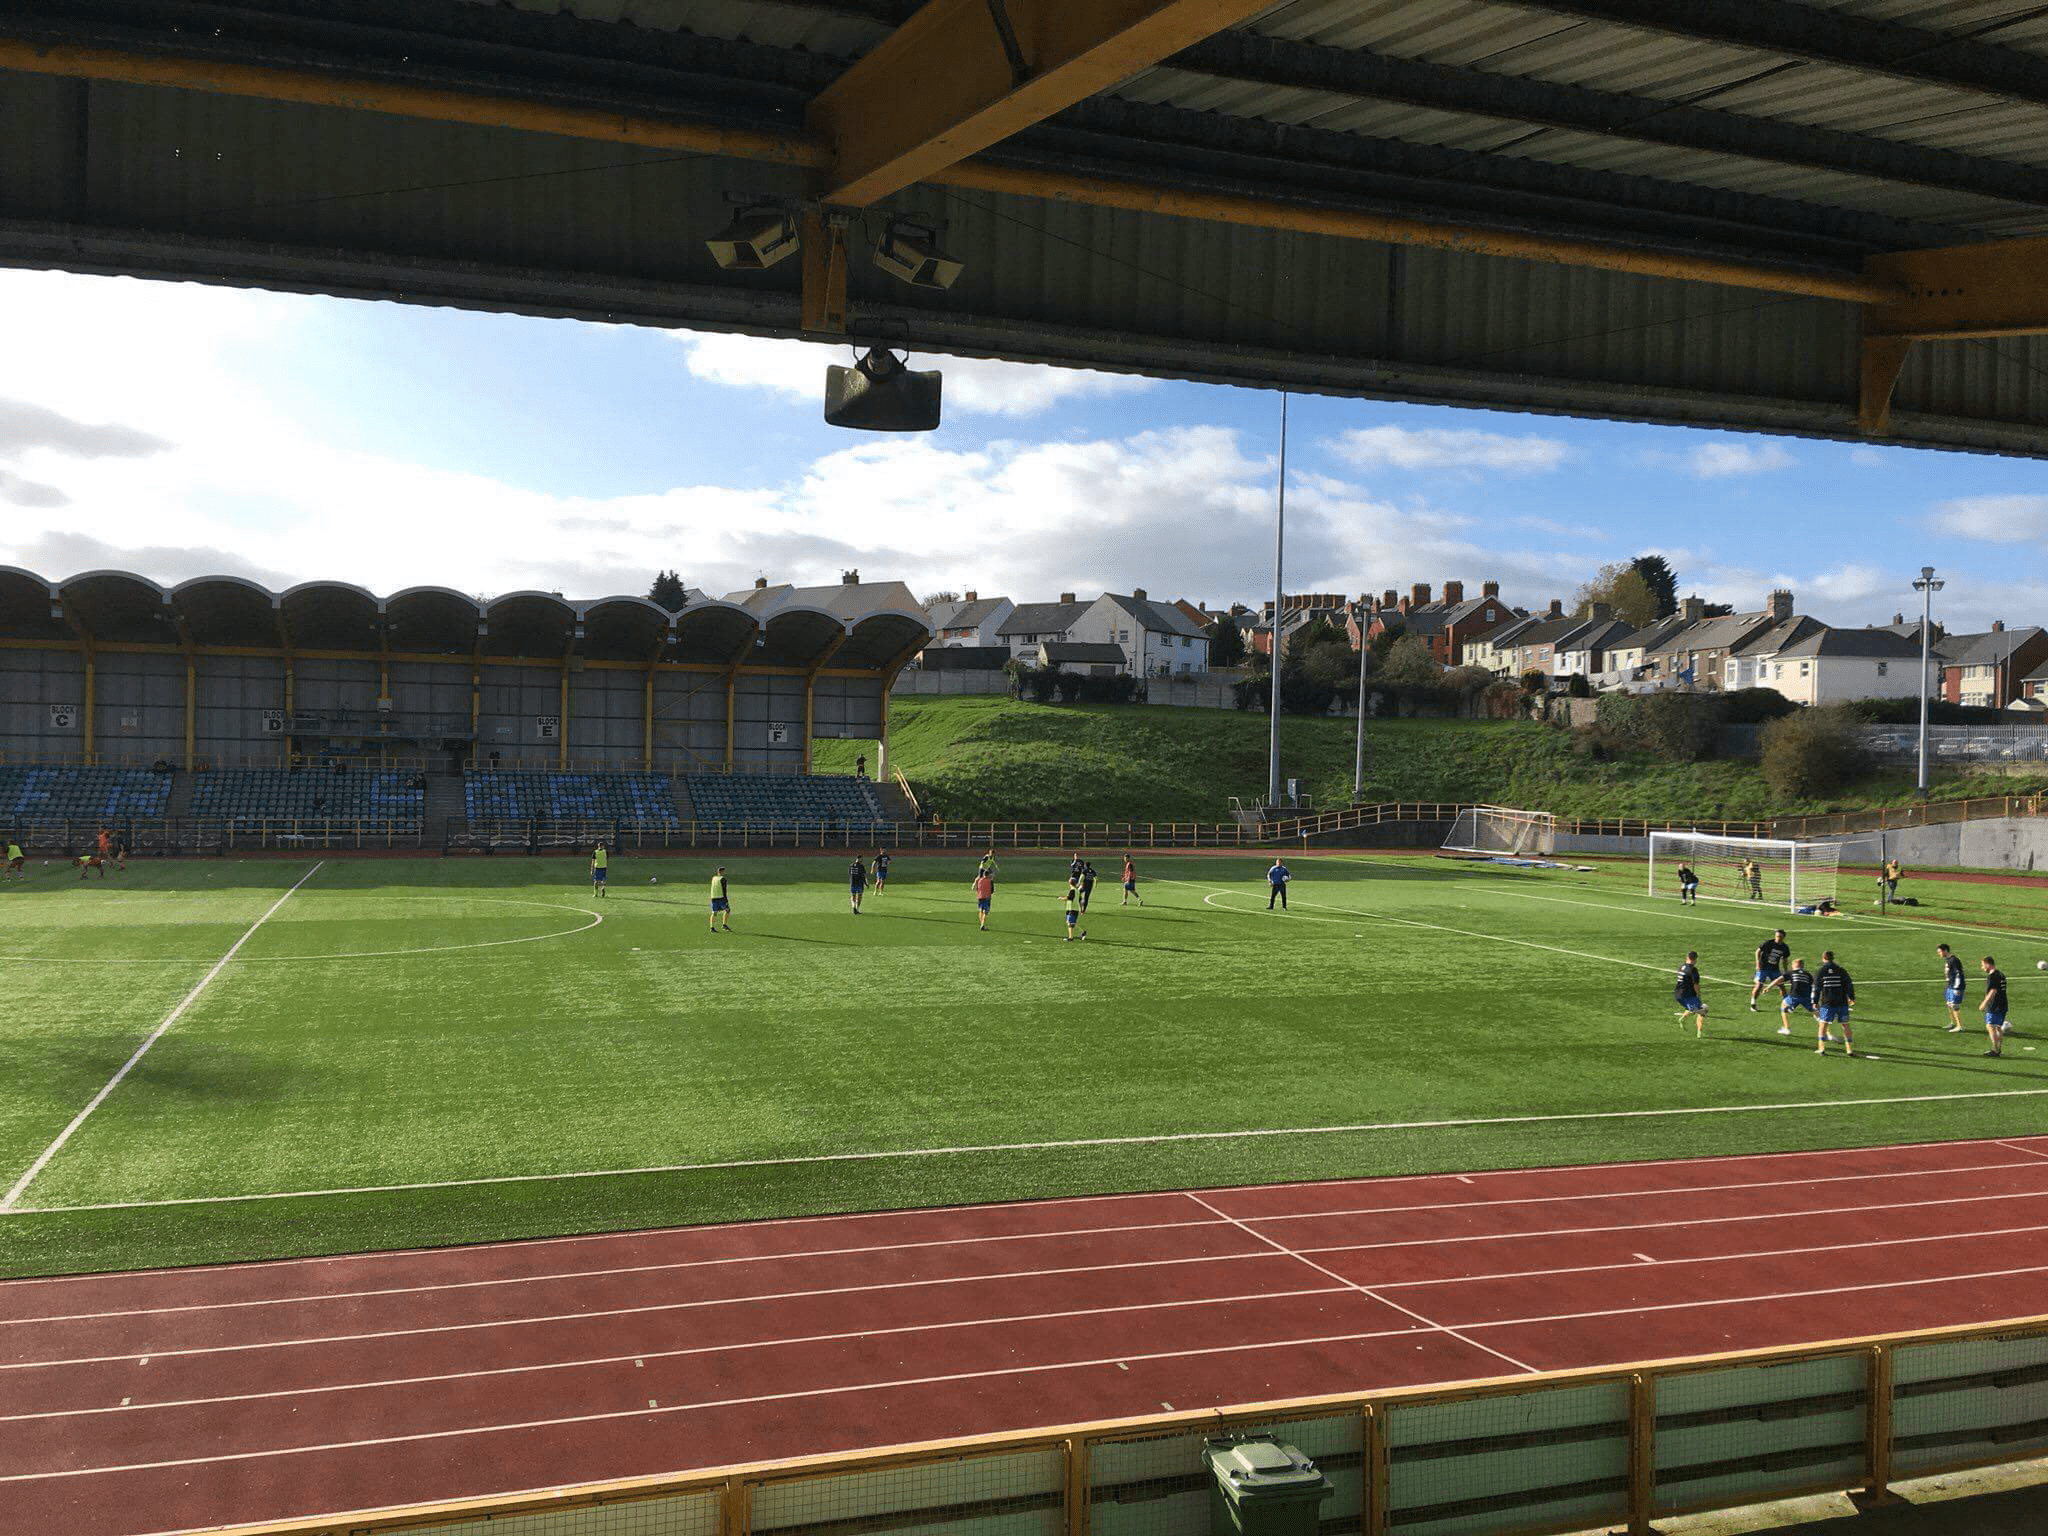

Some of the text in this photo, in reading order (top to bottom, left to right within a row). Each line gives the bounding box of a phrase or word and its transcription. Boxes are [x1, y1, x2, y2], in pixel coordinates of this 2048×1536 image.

[55, 714, 69, 727] C
[268, 719, 281, 731] D
[537, 717, 558, 726] BLOCK
[542, 725, 553, 737] E
[773, 730, 783, 741] F
